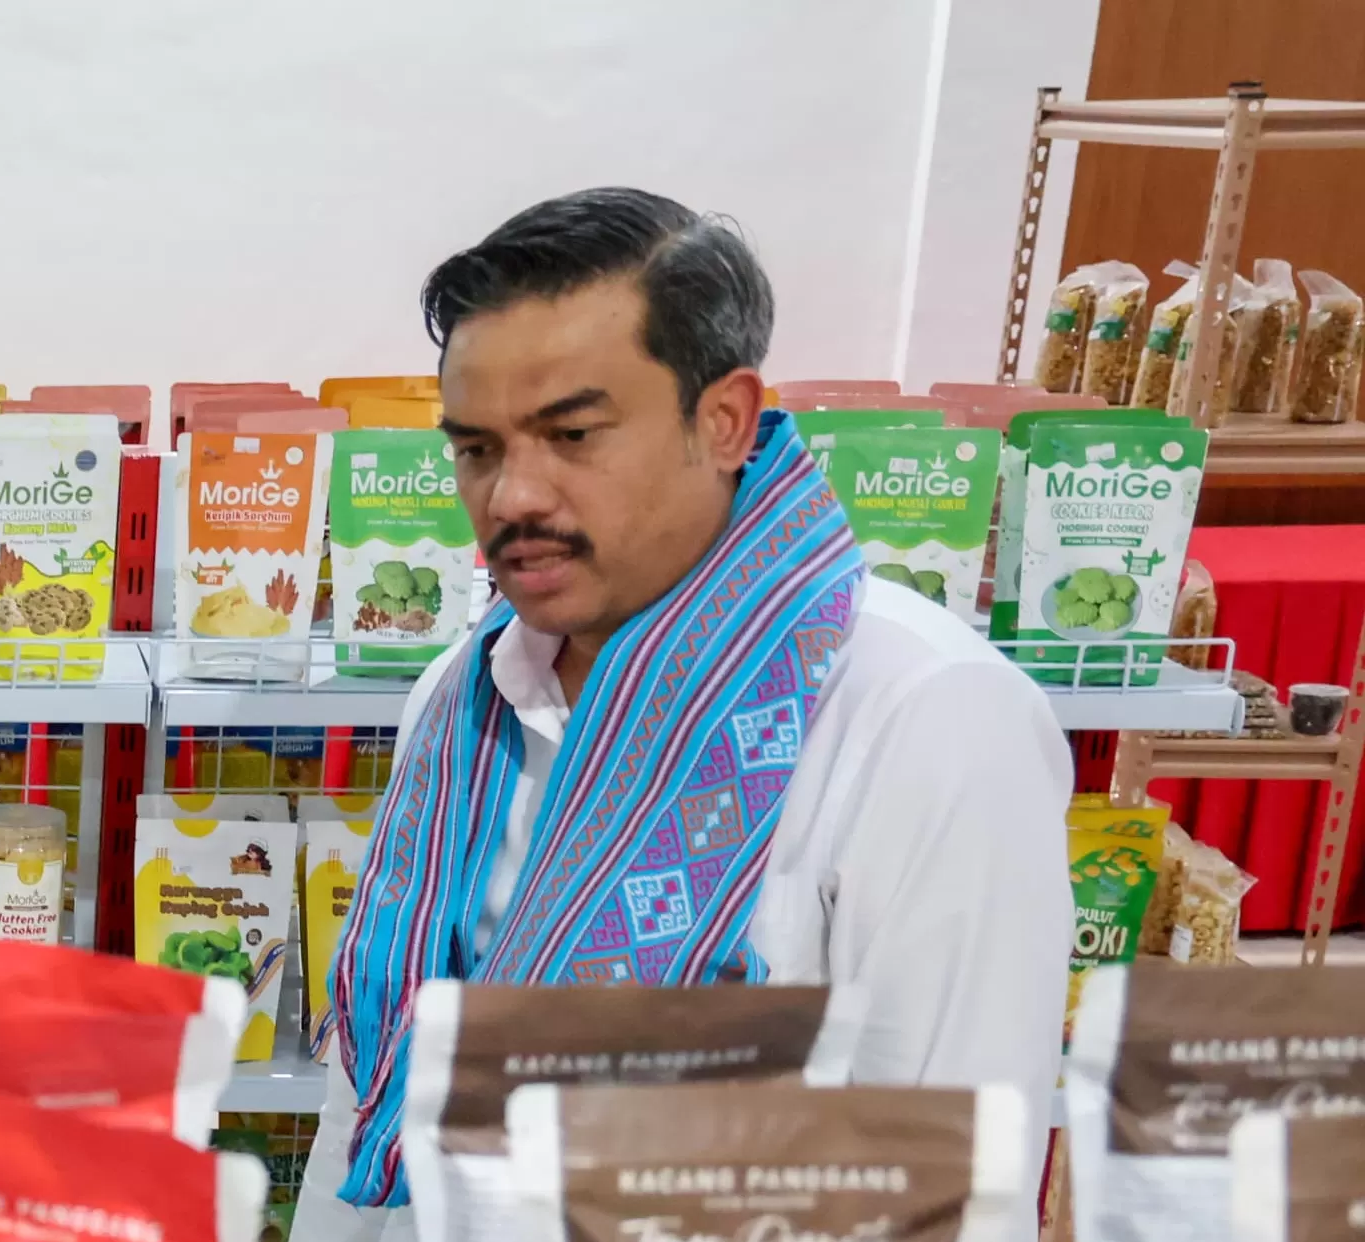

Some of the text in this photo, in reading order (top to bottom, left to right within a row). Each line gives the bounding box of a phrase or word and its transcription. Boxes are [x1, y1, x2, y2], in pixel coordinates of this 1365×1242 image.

[199, 481, 301, 507] MoriGe
[351, 470, 457, 496] MoriGe
[855, 471, 970, 497] MoriGe
[1046, 471, 1172, 500] MoriGe
[205, 510, 292, 523] Keripik Sorghum
[7, 893, 47, 905] MoriGe
[37, 913, 57, 924] Free
[1075, 906, 1116, 924] PULUT
[2, 925, 47, 936] Cookies
[504, 1050, 612, 1076] KACANG
[1170, 1037, 1279, 1066] KACANG
[618, 1166, 908, 1194] KACANG PANGGANG
